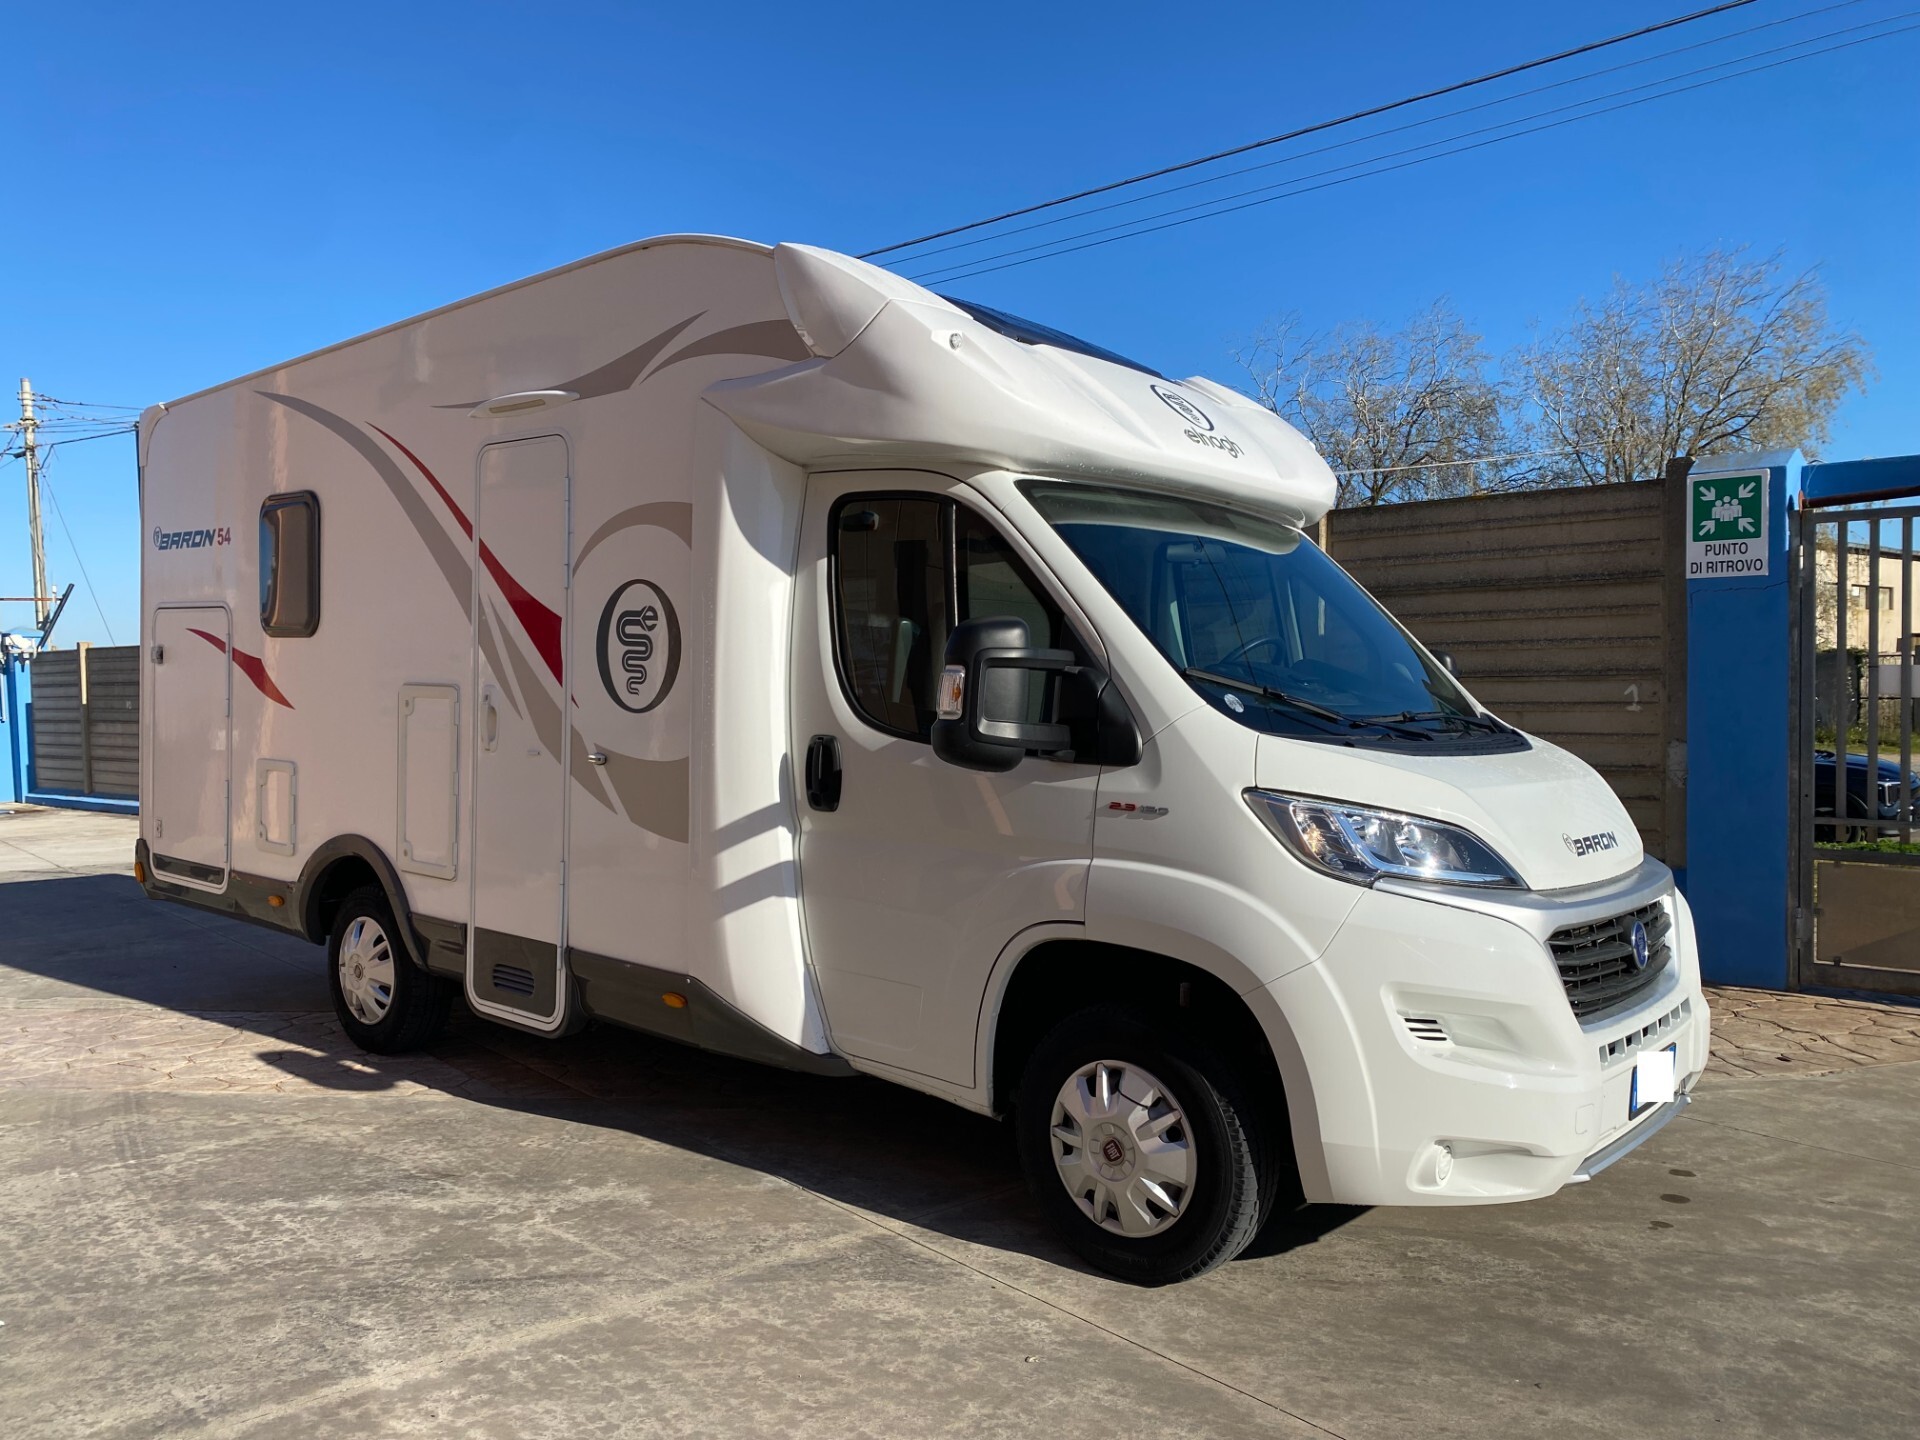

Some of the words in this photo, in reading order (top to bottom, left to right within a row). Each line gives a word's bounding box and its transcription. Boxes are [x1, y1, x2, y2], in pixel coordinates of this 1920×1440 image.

[1184, 427, 1245, 458] elnagh
[158, 529, 216, 551] BARON
[217, 527, 231, 546] 54
[1705, 542, 1748, 556] PUNTO
[1690, 562, 1702, 574] DI
[1706, 559, 1763, 574] RITROVO
[1624, 683, 1643, 711] 1
[1573, 831, 1618, 857] BARON
